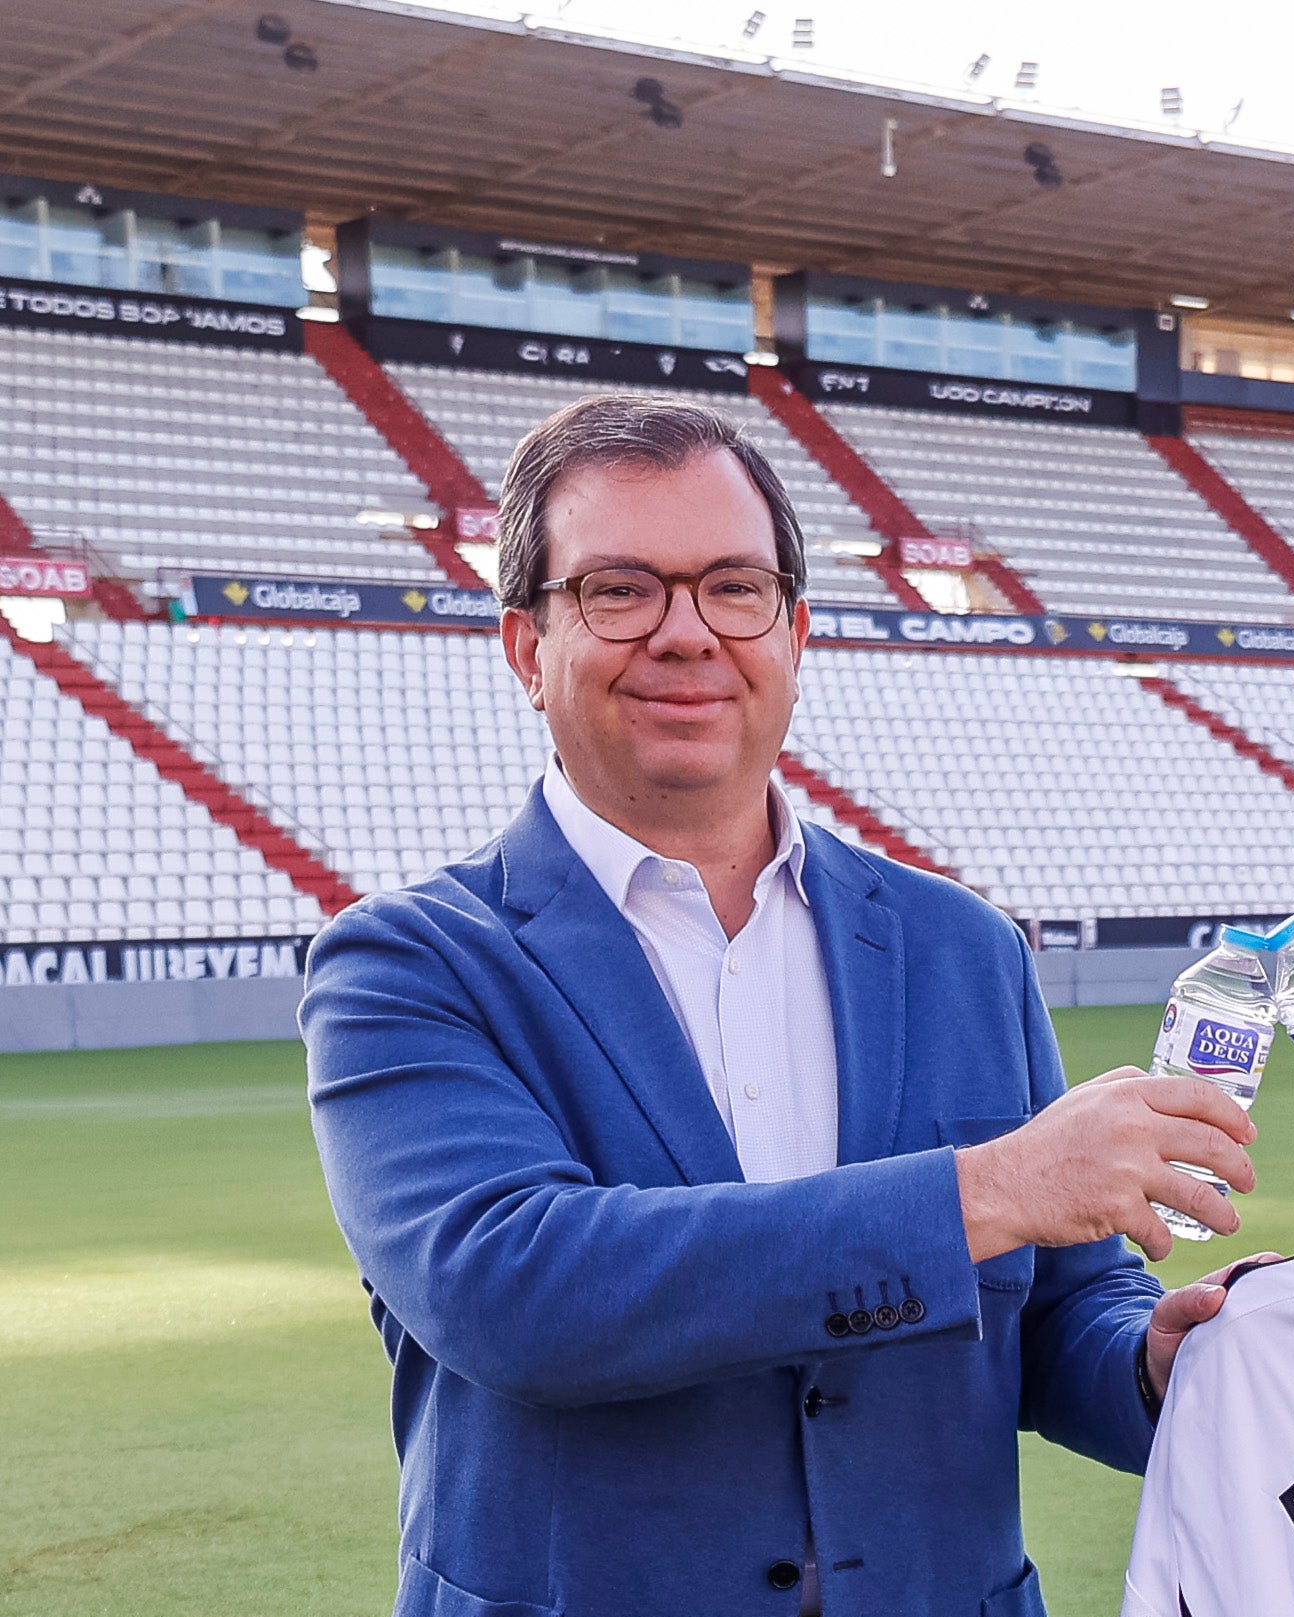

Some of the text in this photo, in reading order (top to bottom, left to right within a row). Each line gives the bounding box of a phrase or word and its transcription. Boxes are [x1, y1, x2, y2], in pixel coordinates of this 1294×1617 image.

[8, 289, 115, 320] TODOS
[253, 583, 361, 617] Globalcaja
[900, 617, 1036, 645] CAMPO
[1200, 1024, 1254, 1050] AQUA
[1198, 1039, 1250, 1064] DEUS
